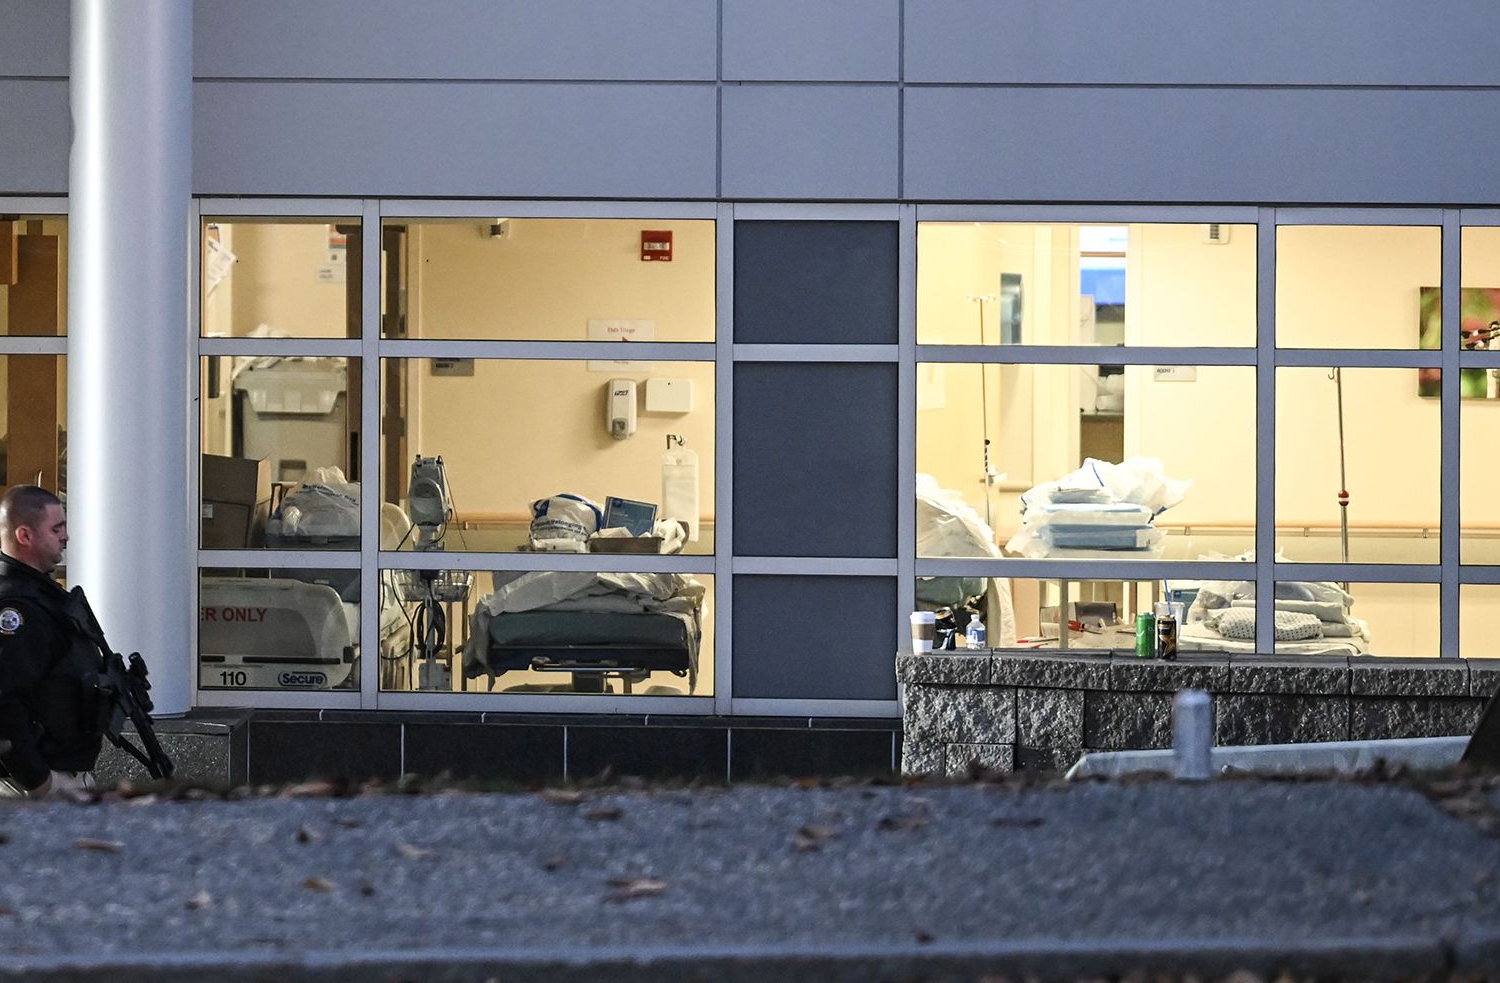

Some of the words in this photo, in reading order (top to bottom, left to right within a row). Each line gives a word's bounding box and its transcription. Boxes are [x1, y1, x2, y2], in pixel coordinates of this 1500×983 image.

[222, 608, 267, 622] ONLY
[220, 671, 246, 686] 110
[282, 673, 324, 684] Secure
